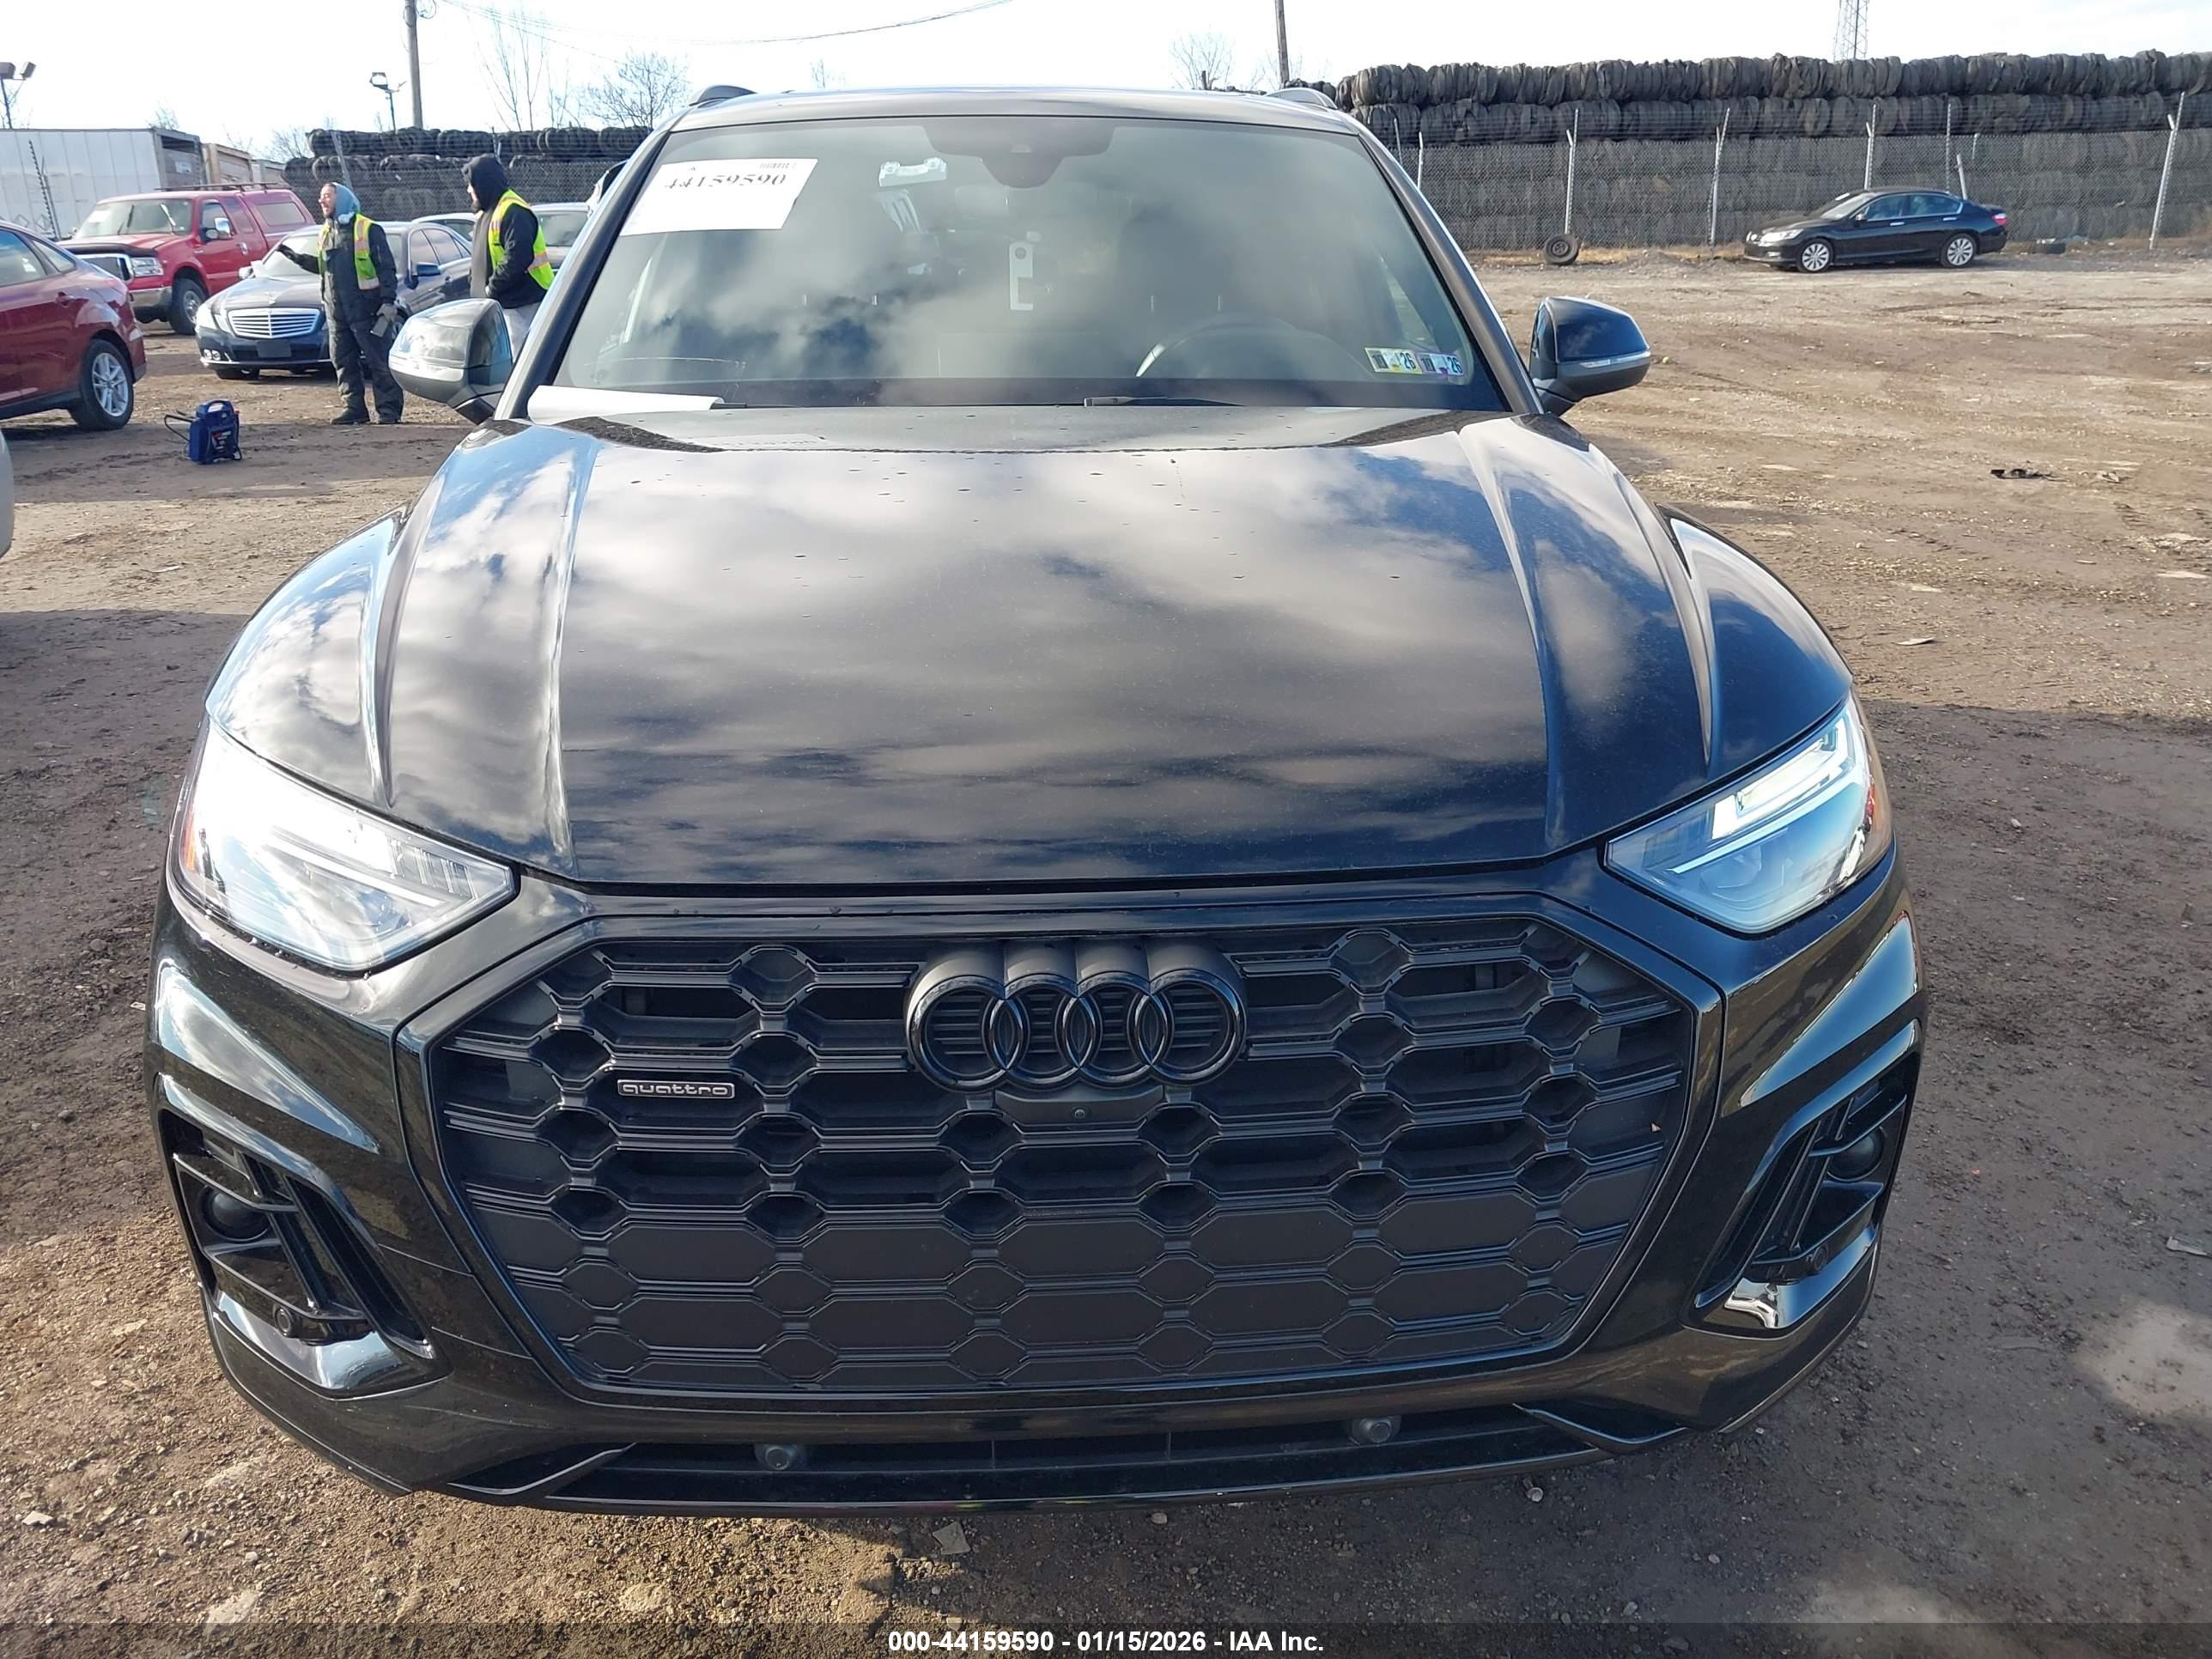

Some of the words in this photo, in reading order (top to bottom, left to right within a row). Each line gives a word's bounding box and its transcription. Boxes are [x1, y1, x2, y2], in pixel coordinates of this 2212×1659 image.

[1400, 352, 1417, 370] 26
[1447, 356, 1463, 374] 26
[623, 1084, 728, 1096] quattro
